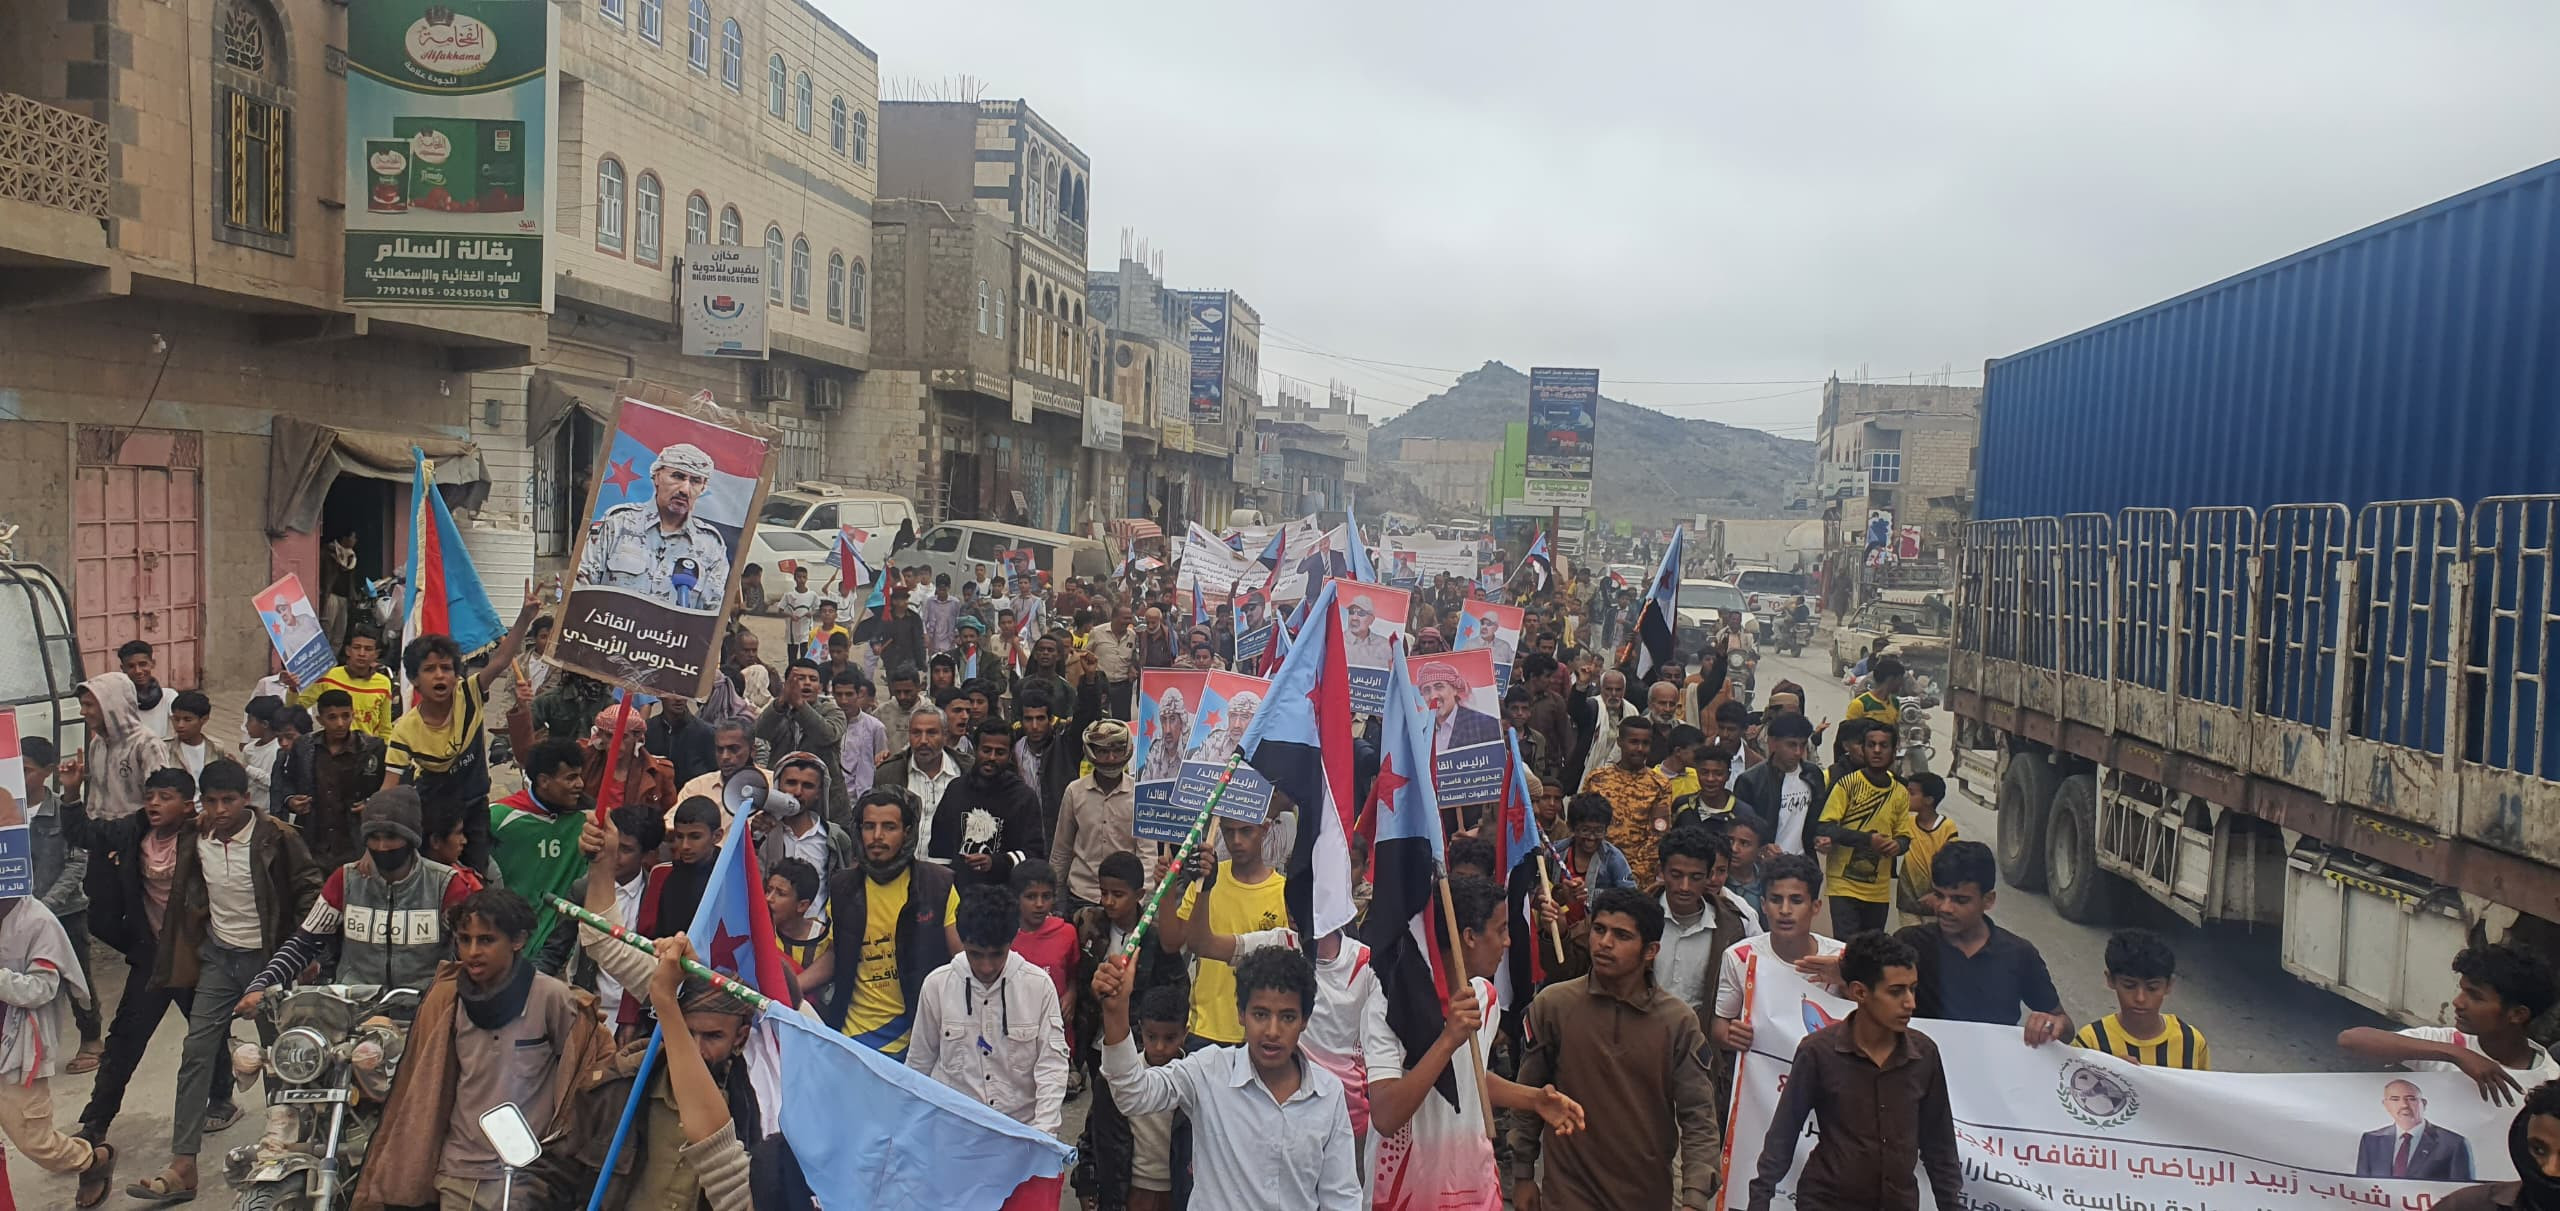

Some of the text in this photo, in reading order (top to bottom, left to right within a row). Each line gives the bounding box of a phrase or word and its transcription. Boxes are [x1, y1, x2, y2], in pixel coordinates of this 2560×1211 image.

[420, 50, 482, 62] Alfakhama
[374, 238, 513, 267] بقالة السلام
[711, 250, 740, 262] مخازن
[442, 268, 485, 284] الغذائية
[487, 271, 521, 284] للمواد
[718, 274, 735, 283] DRUG
[376, 286, 434, 296] 779124185
[444, 288, 494, 298] 02435034
[584, 608, 689, 649] الرئيس القائد/
[629, 650, 699, 676] عيدروس
[1352, 675, 1382, 687] الرئيس
[1456, 755, 1489, 770] الرئيس
[537, 838, 561, 859] 16
[8, 882, 24, 891] قائد
[347, 917, 365, 933] Ba
[416, 922, 429, 936] N
[2012, 1144, 2118, 1171] الثقافي
[2127, 1157, 2236, 1187] الرياضي
[2309, 1183, 2392, 1208] شباب
